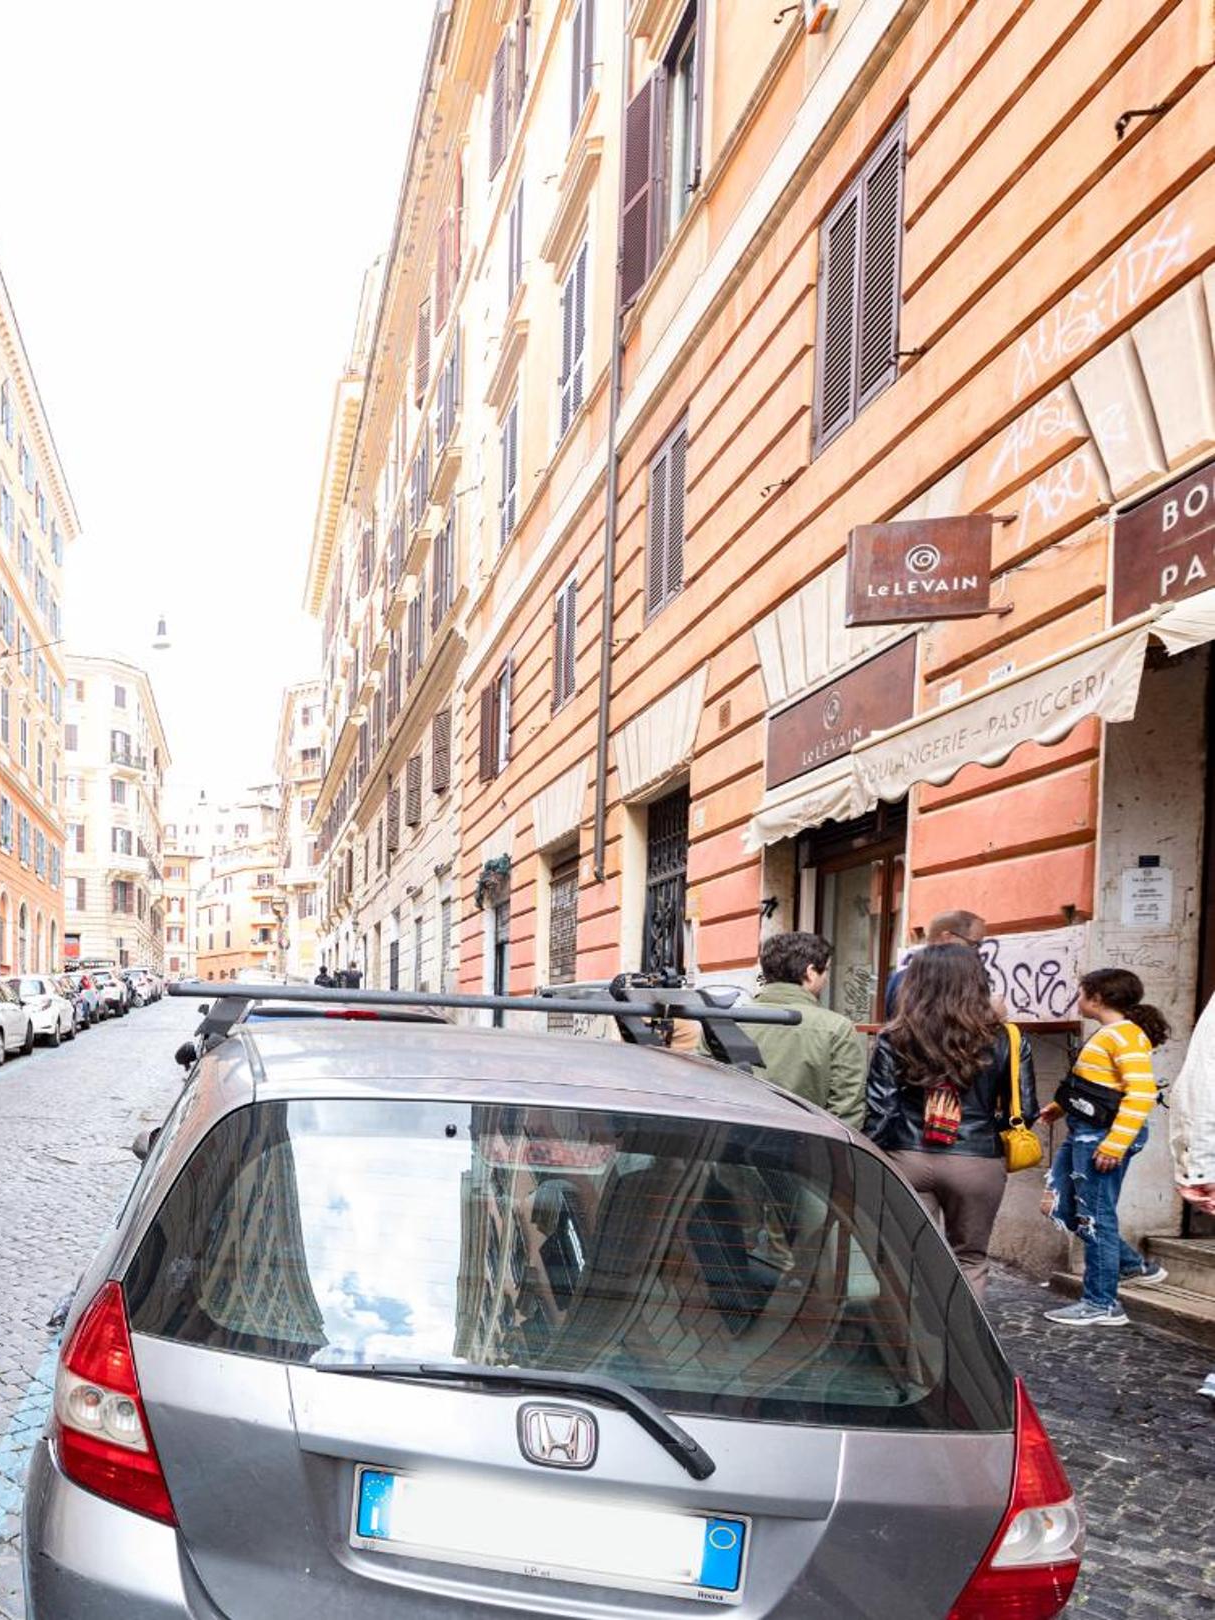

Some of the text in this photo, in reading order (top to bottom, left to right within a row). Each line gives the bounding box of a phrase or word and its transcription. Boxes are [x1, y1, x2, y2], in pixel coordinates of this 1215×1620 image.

[1162, 478, 1215, 532] BO
[1160, 545, 1215, 597] PA
[863, 728, 967, 783] OULANGERIE
[987, 671, 1114, 737] PASTICCERI
